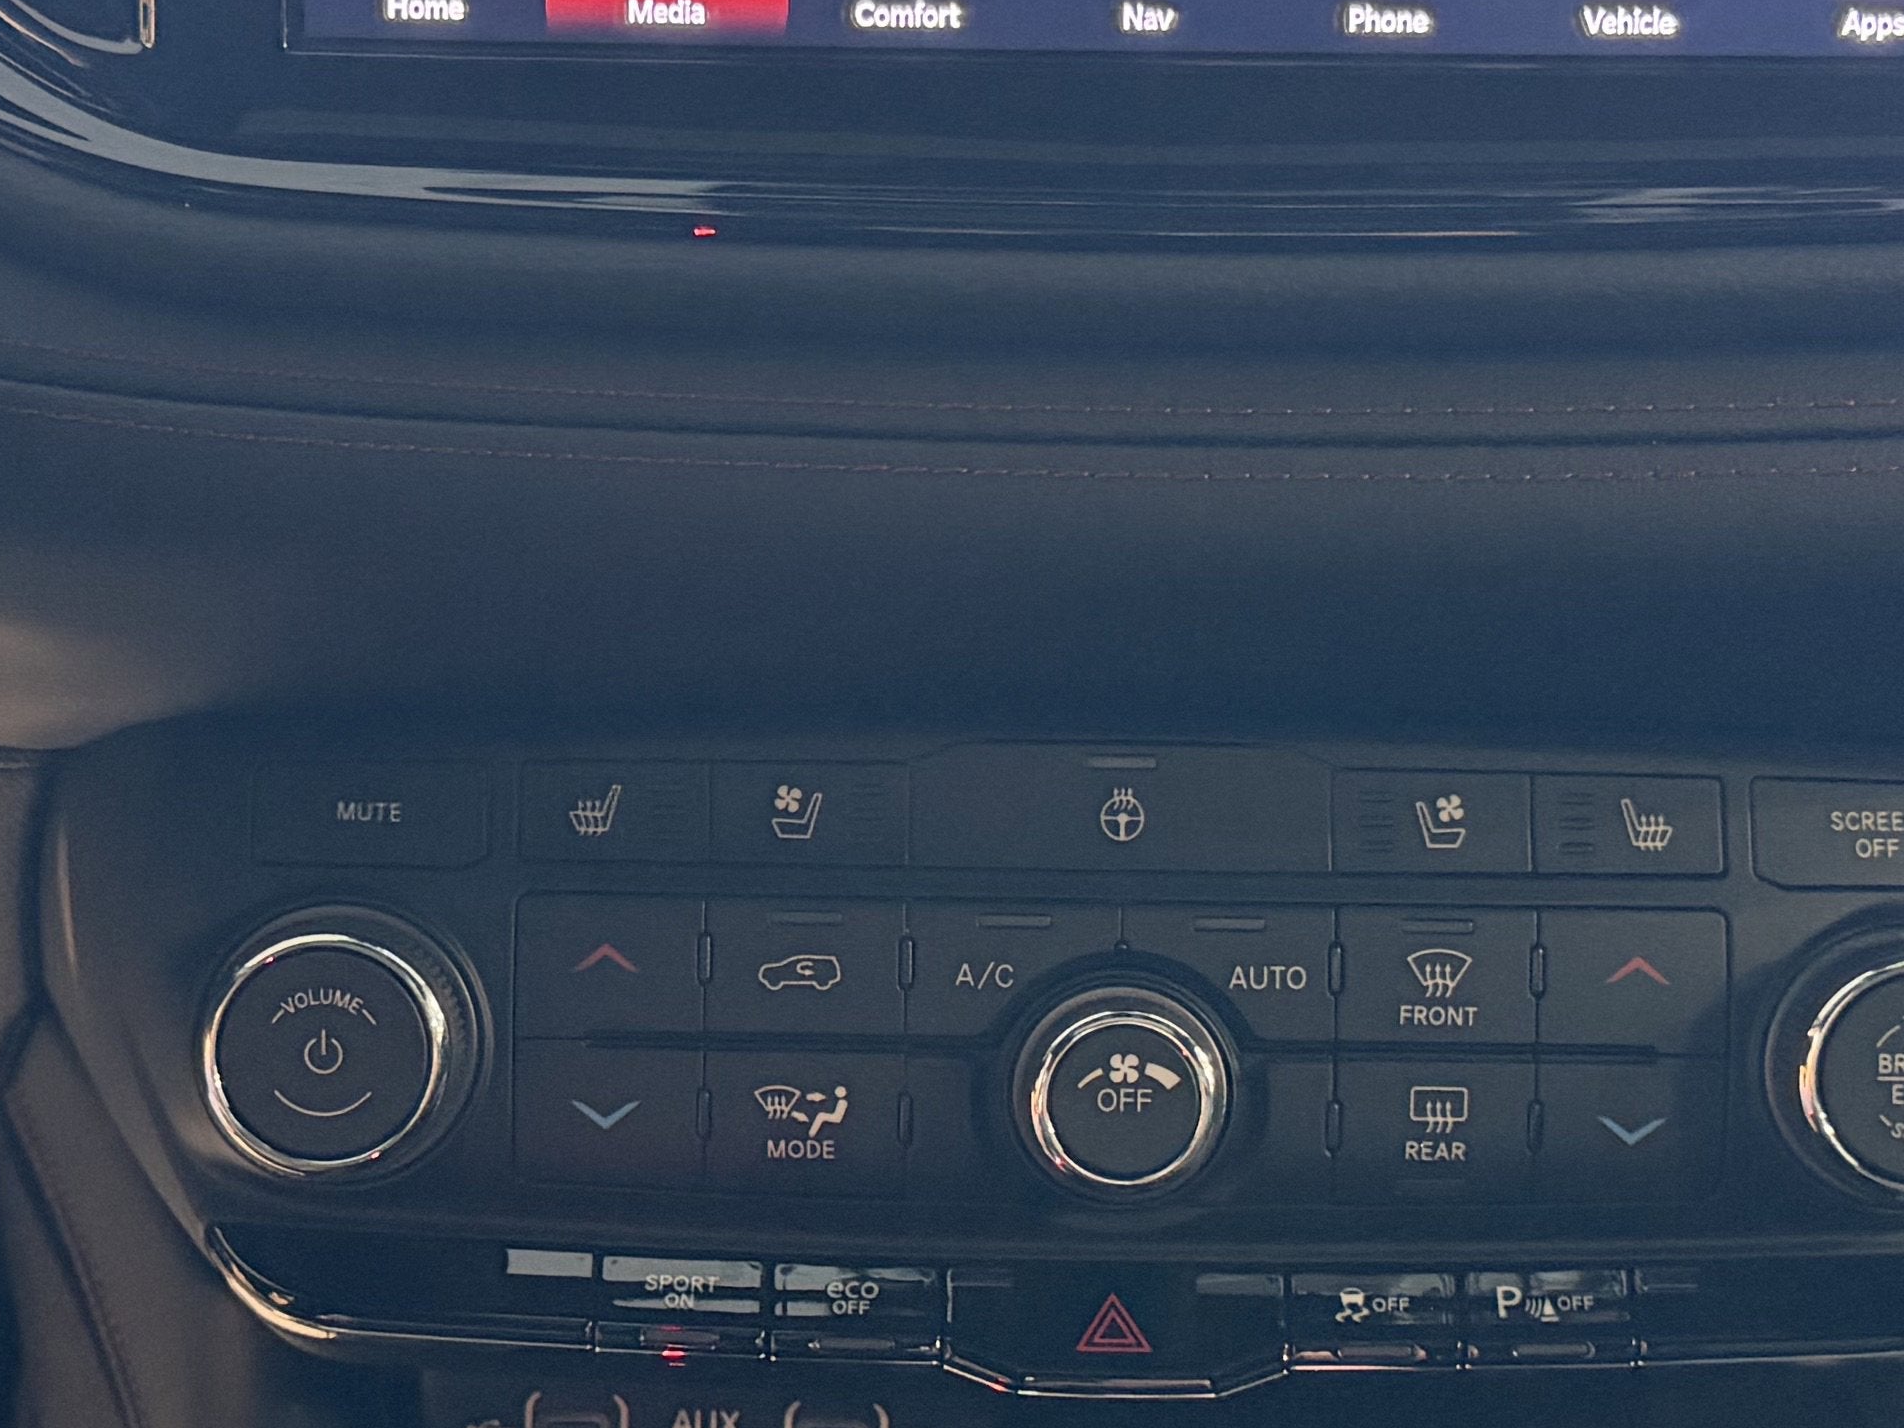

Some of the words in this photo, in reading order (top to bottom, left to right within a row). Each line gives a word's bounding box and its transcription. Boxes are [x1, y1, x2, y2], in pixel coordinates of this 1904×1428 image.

[1122, 3, 1177, 34] Nav
[1347, 6, 1430, 35] Phone
[1582, 6, 1678, 37] Vehicle
[336, 801, 402, 823] MUTE
[1854, 838, 1901, 860] OFF
[954, 963, 1015, 991] A/C
[1228, 965, 1309, 991] AUTO
[281, 987, 365, 1015] VOLUME
[1398, 1004, 1479, 1028] FRONT
[1096, 1087, 1154, 1113] OFF
[766, 1138, 836, 1161] MODE
[1404, 1140, 1467, 1163] REAR
[644, 1273, 721, 1296] SPORT
[664, 1291, 696, 1311] ON
[832, 1299, 872, 1317] OFF
[1372, 1296, 1411, 1316] OFF
[1496, 1285, 1523, 1319] P
[1557, 1292, 1595, 1313] OFF
